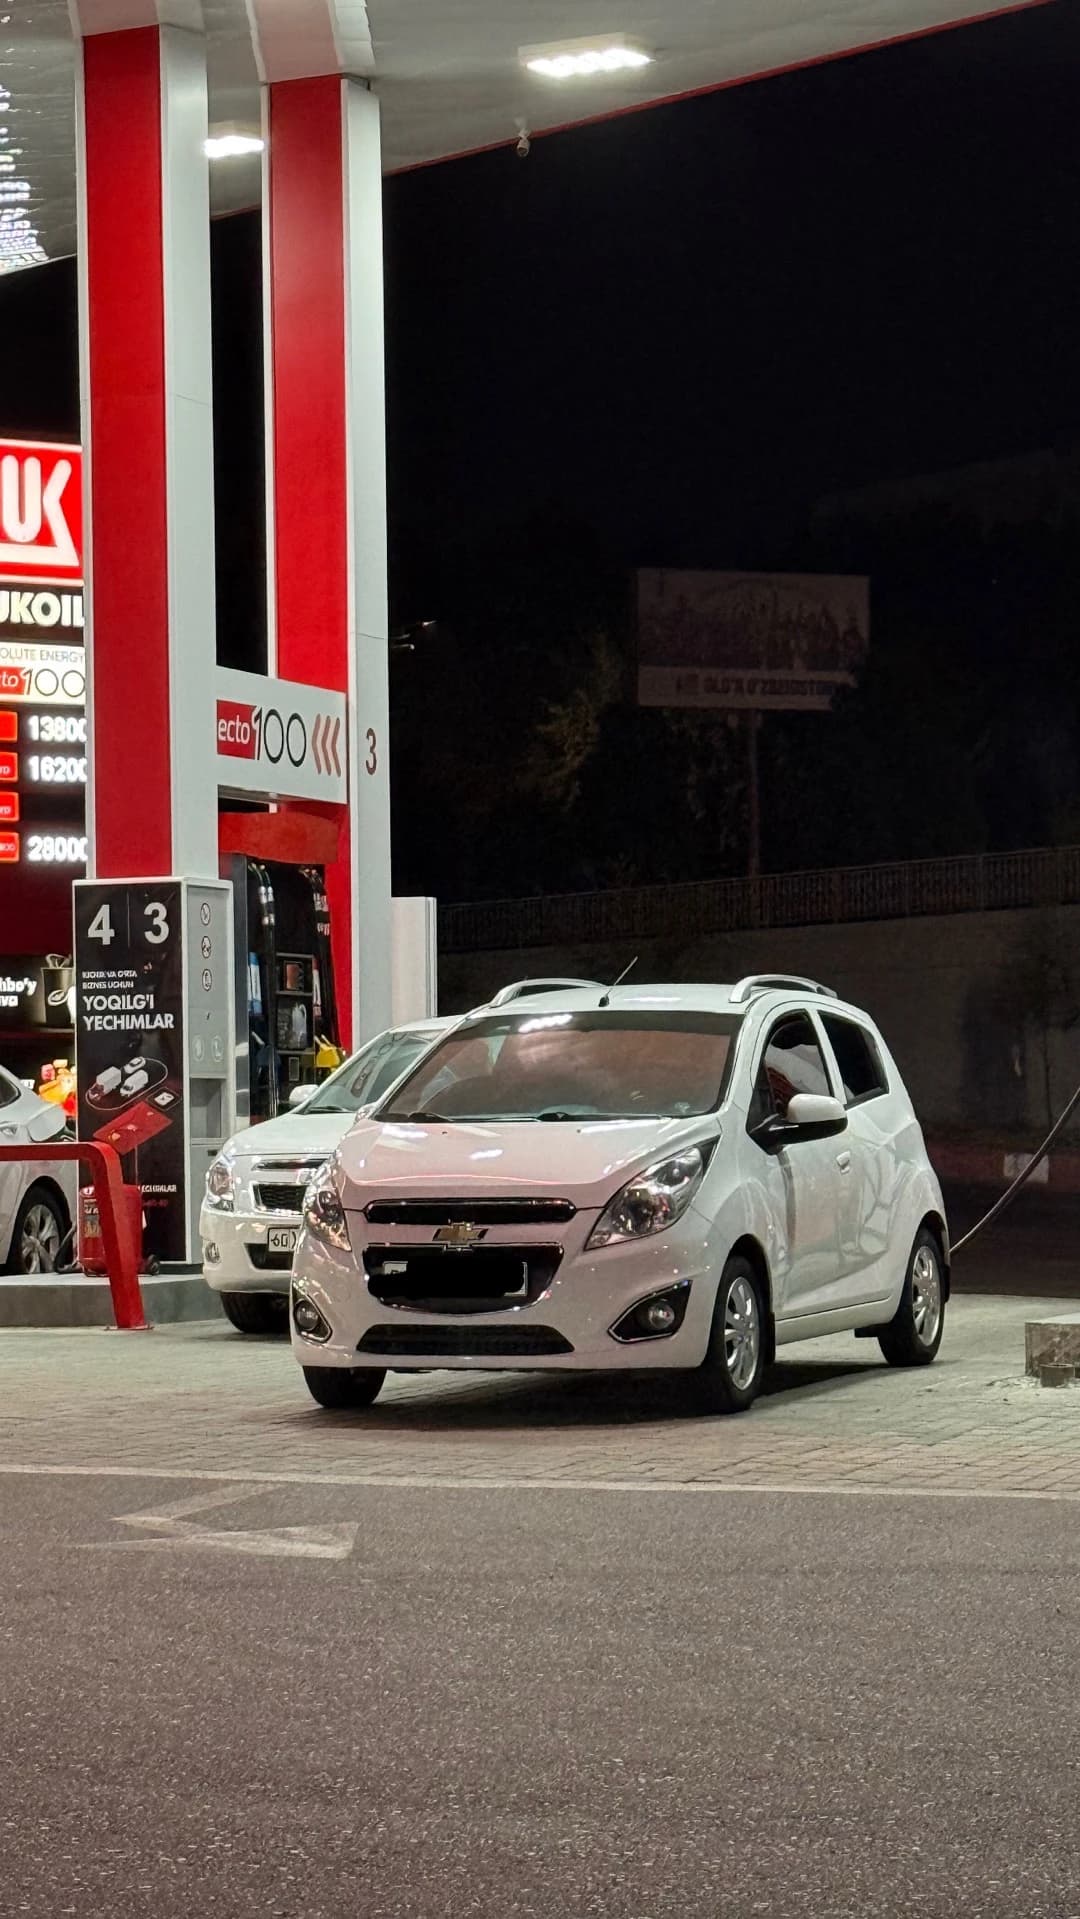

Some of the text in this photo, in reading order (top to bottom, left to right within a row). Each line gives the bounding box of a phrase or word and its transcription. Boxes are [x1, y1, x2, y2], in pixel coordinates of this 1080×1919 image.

[365, 727, 377, 775] 3
[28, 755, 87, 782] 16200
[27, 835, 88, 862] 28000
[87, 904, 115, 945] 4
[144, 902, 169, 944] 3
[82, 994, 155, 1012] YOQILG'I
[82, 1013, 175, 1032] YECHIMLAR
